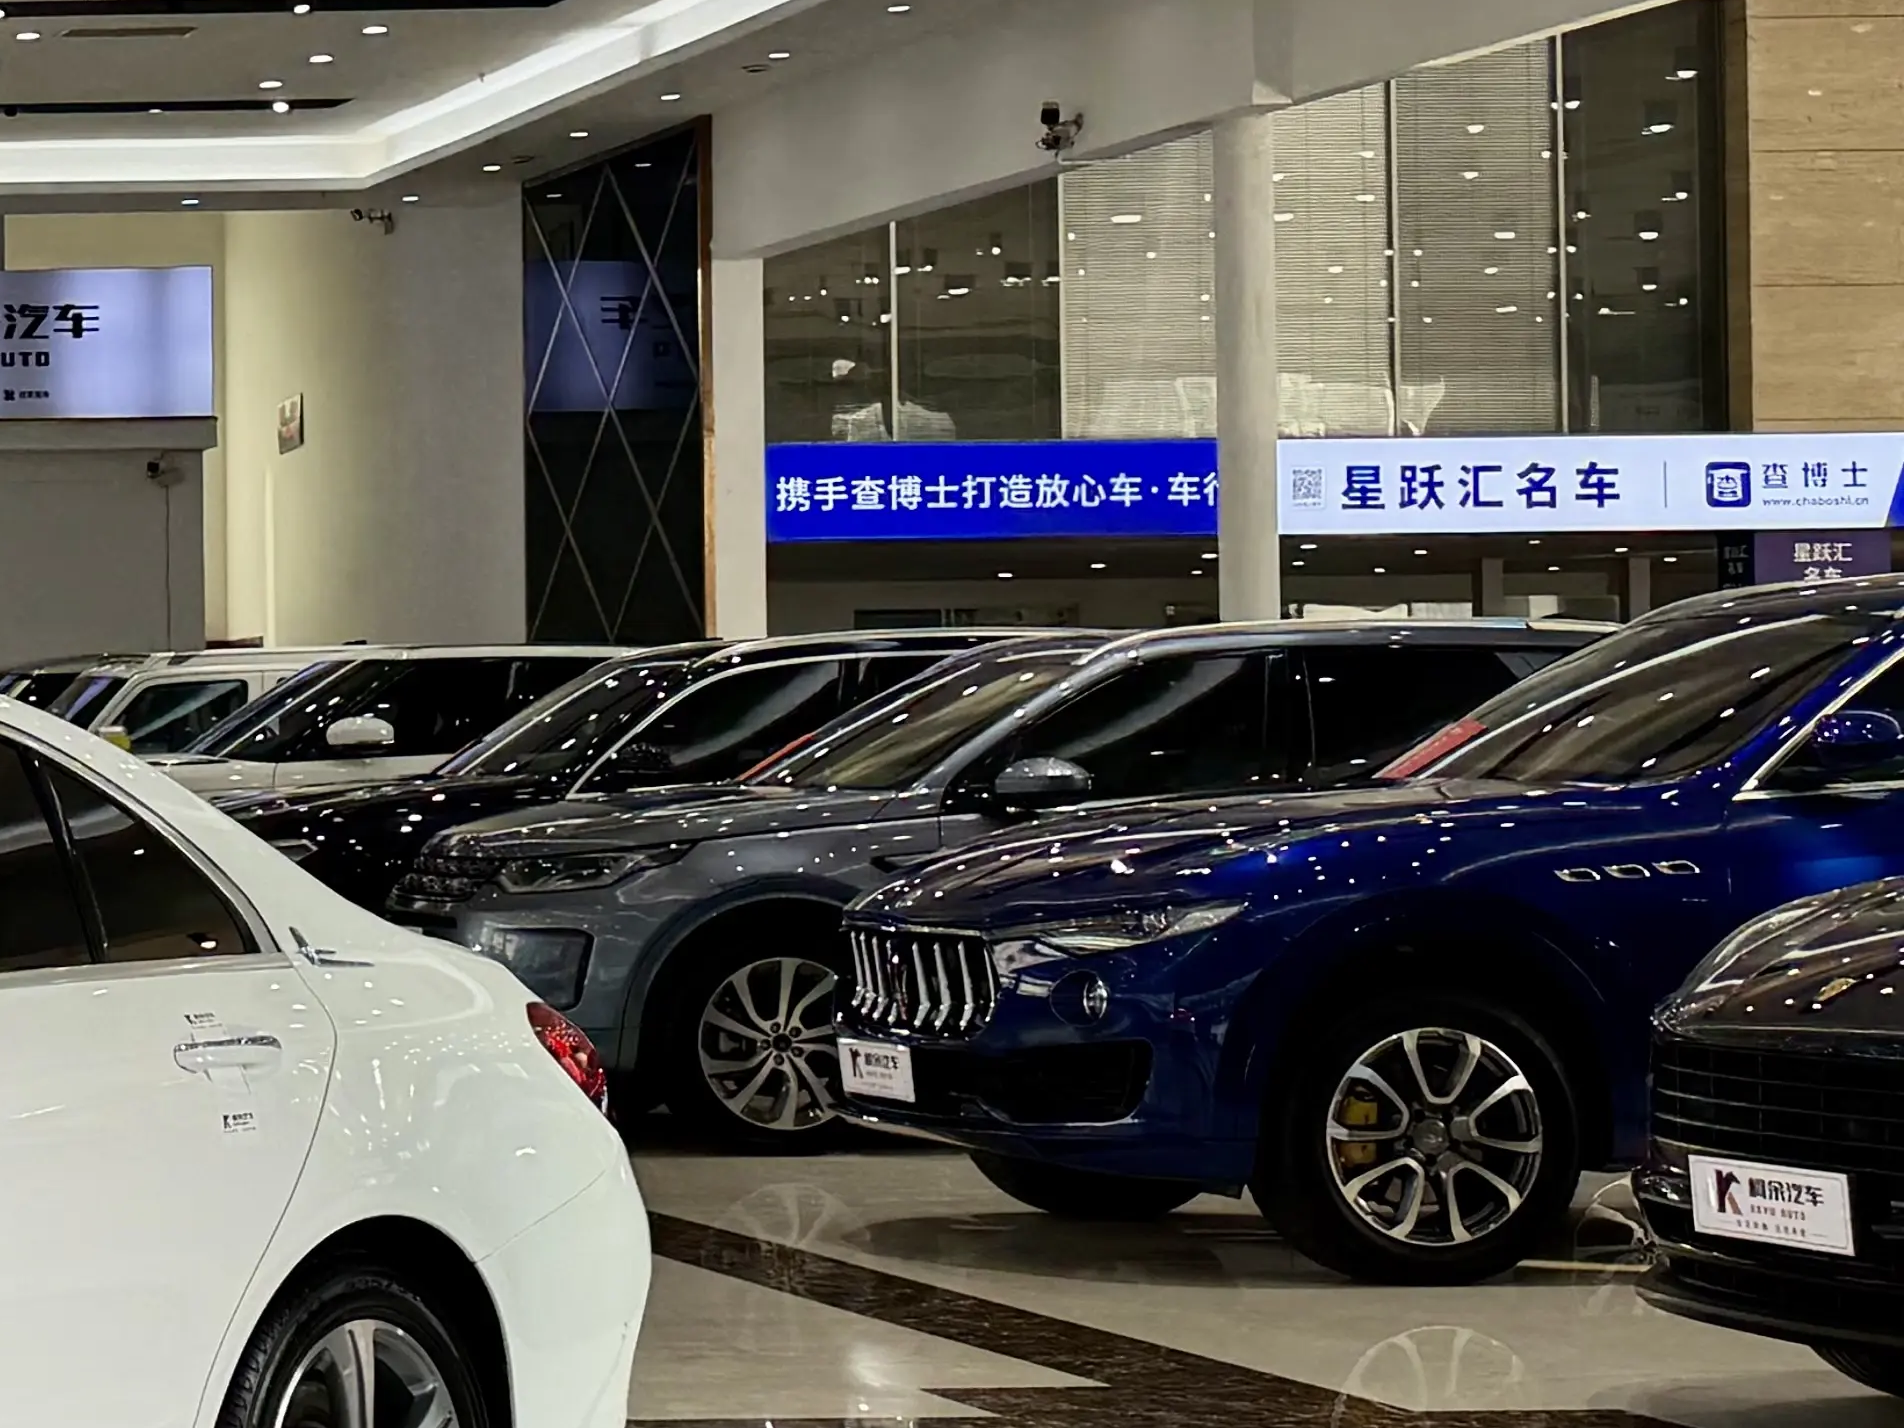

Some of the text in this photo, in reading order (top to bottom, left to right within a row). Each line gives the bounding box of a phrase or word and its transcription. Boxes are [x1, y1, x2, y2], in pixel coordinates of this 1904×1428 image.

[1341, 461, 1622, 510] 星跃汇名车
[1761, 460, 1868, 489] 查博士
